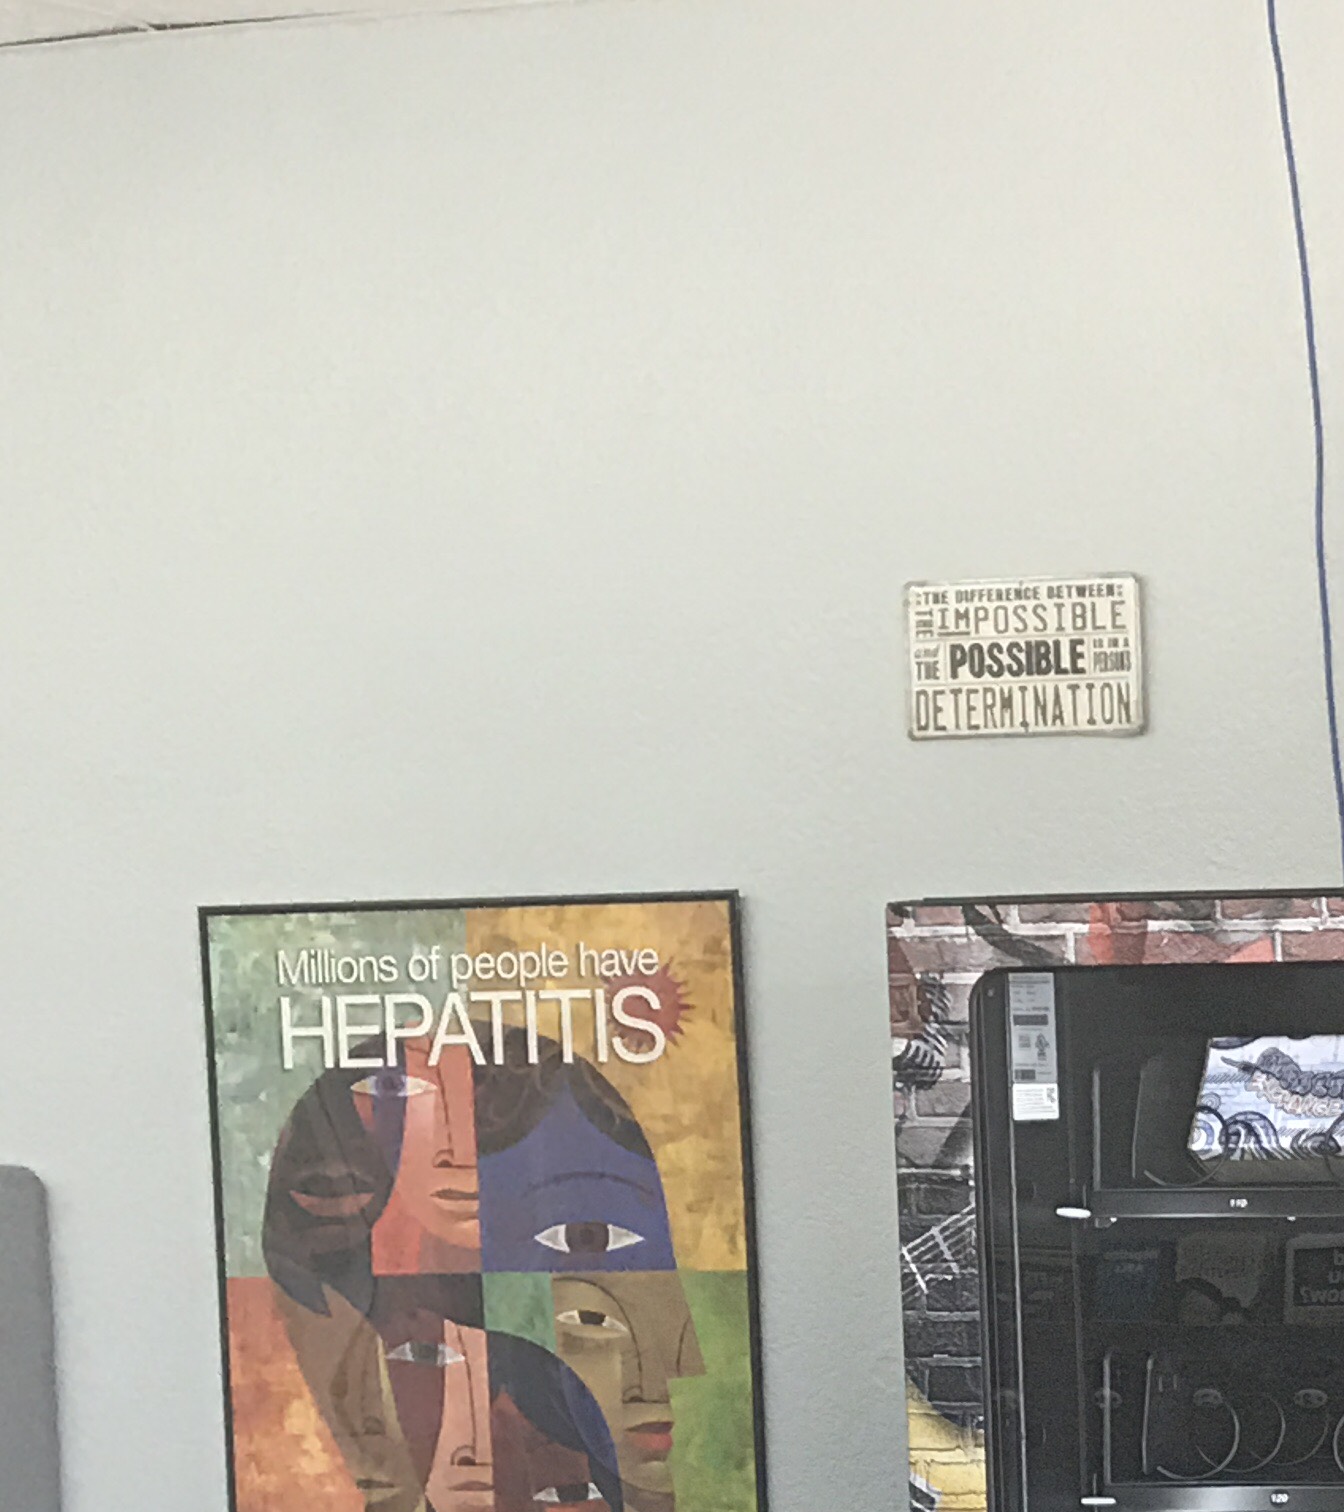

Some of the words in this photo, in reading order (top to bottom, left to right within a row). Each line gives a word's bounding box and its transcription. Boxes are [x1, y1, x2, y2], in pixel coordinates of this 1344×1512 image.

[923, 590, 948, 605] THE
[955, 586, 1040, 604] DIFFERENCE
[1047, 584, 1115, 600] BETWEEN
[937, 600, 1127, 634] IMPOSSIBLE
[915, 660, 940, 681] THE
[950, 638, 1086, 679] POSSIBLE
[915, 682, 1131, 731] DETERMINATION
[277, 948, 398, 985] Millions
[408, 945, 439, 982] of
[452, 943, 569, 987] people
[578, 942, 660, 977] have
[278, 984, 667, 1070] HEPATITIS
